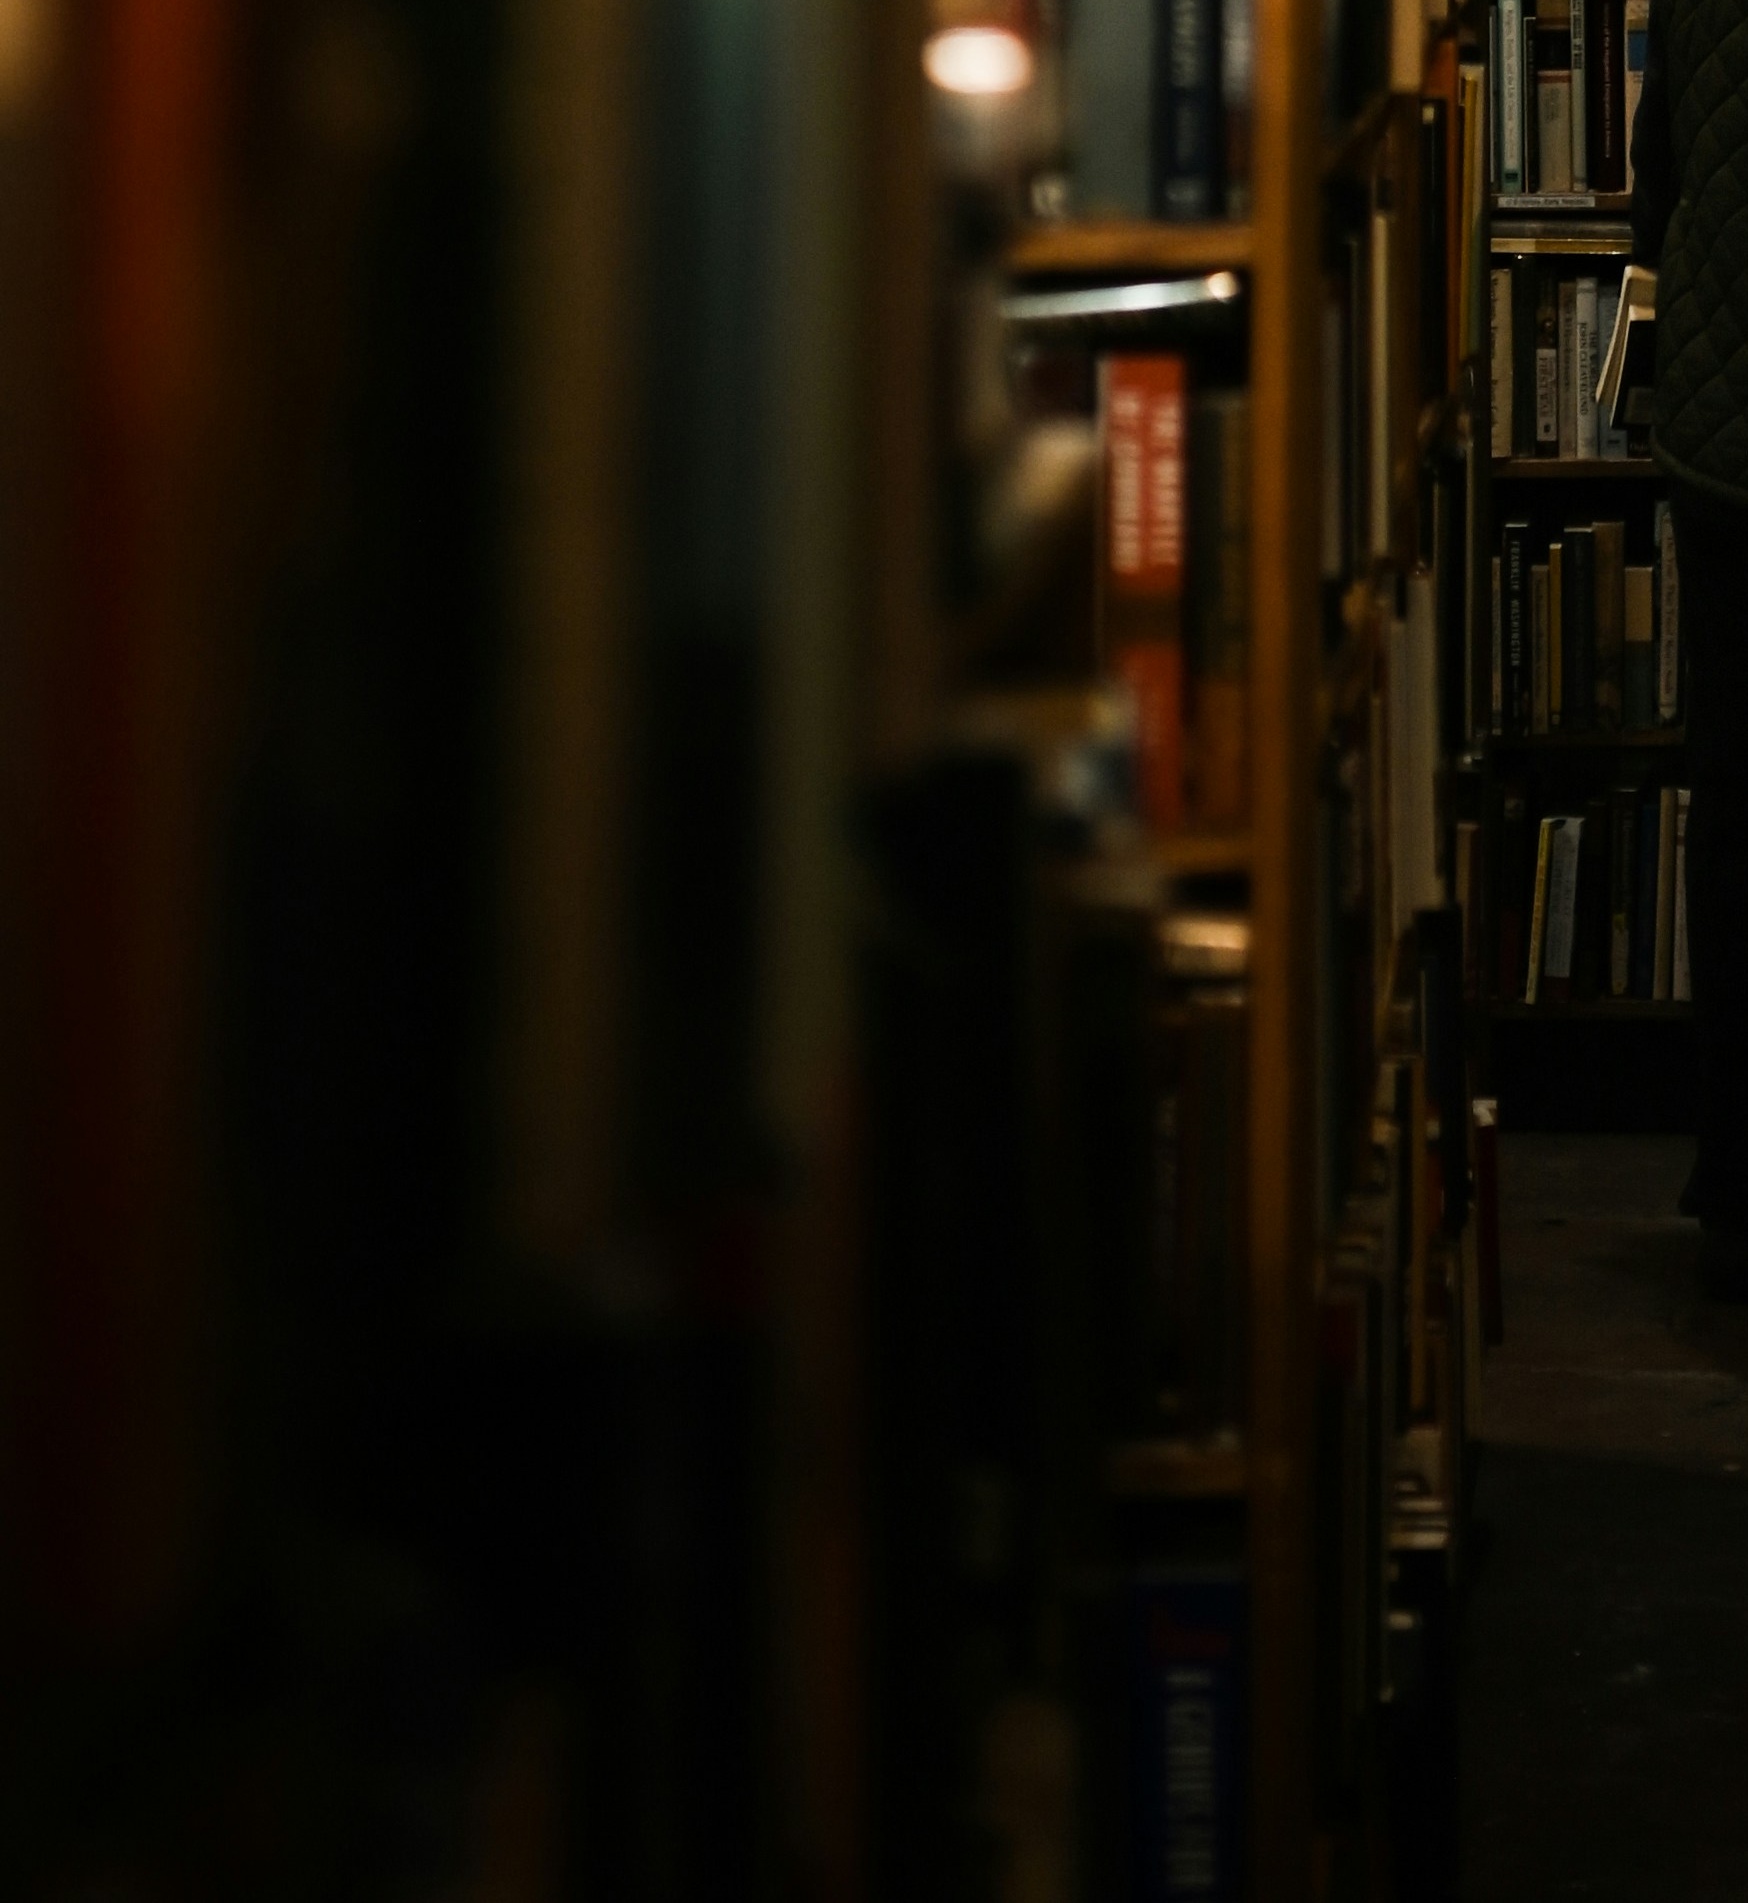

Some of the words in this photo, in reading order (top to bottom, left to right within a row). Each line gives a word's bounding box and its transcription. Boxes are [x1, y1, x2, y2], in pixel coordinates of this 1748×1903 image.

[1603, 83, 1611, 120] Emigration
[1579, 323, 1588, 348] JOHN
[1538, 357, 1549, 388] FIRST
[1539, 392, 1549, 418] WAR
